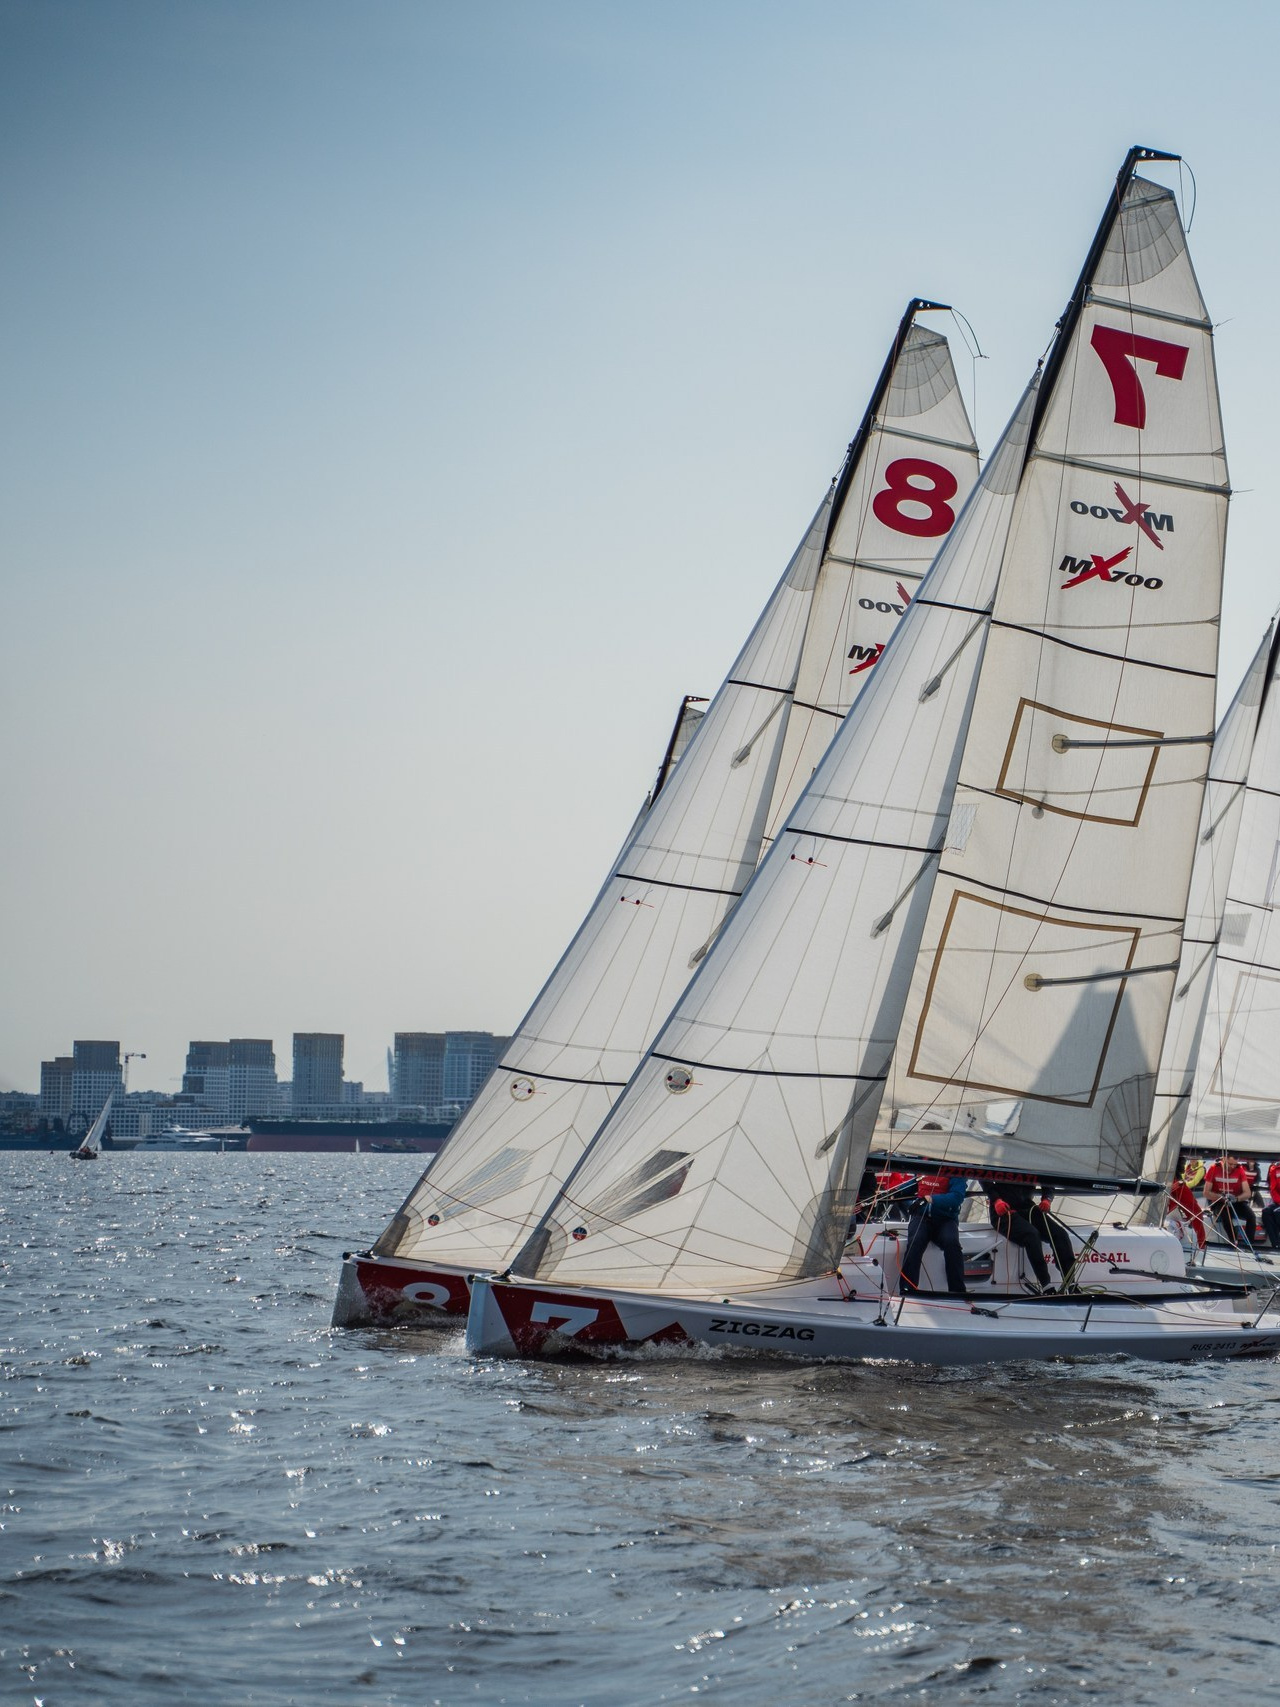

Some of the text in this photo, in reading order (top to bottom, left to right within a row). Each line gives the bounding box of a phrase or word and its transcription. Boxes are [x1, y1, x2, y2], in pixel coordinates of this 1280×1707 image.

[872, 457, 958, 537] 8
[1058, 546, 1164, 590] MX700
[709, 1319, 815, 1341] ZIGZAG
